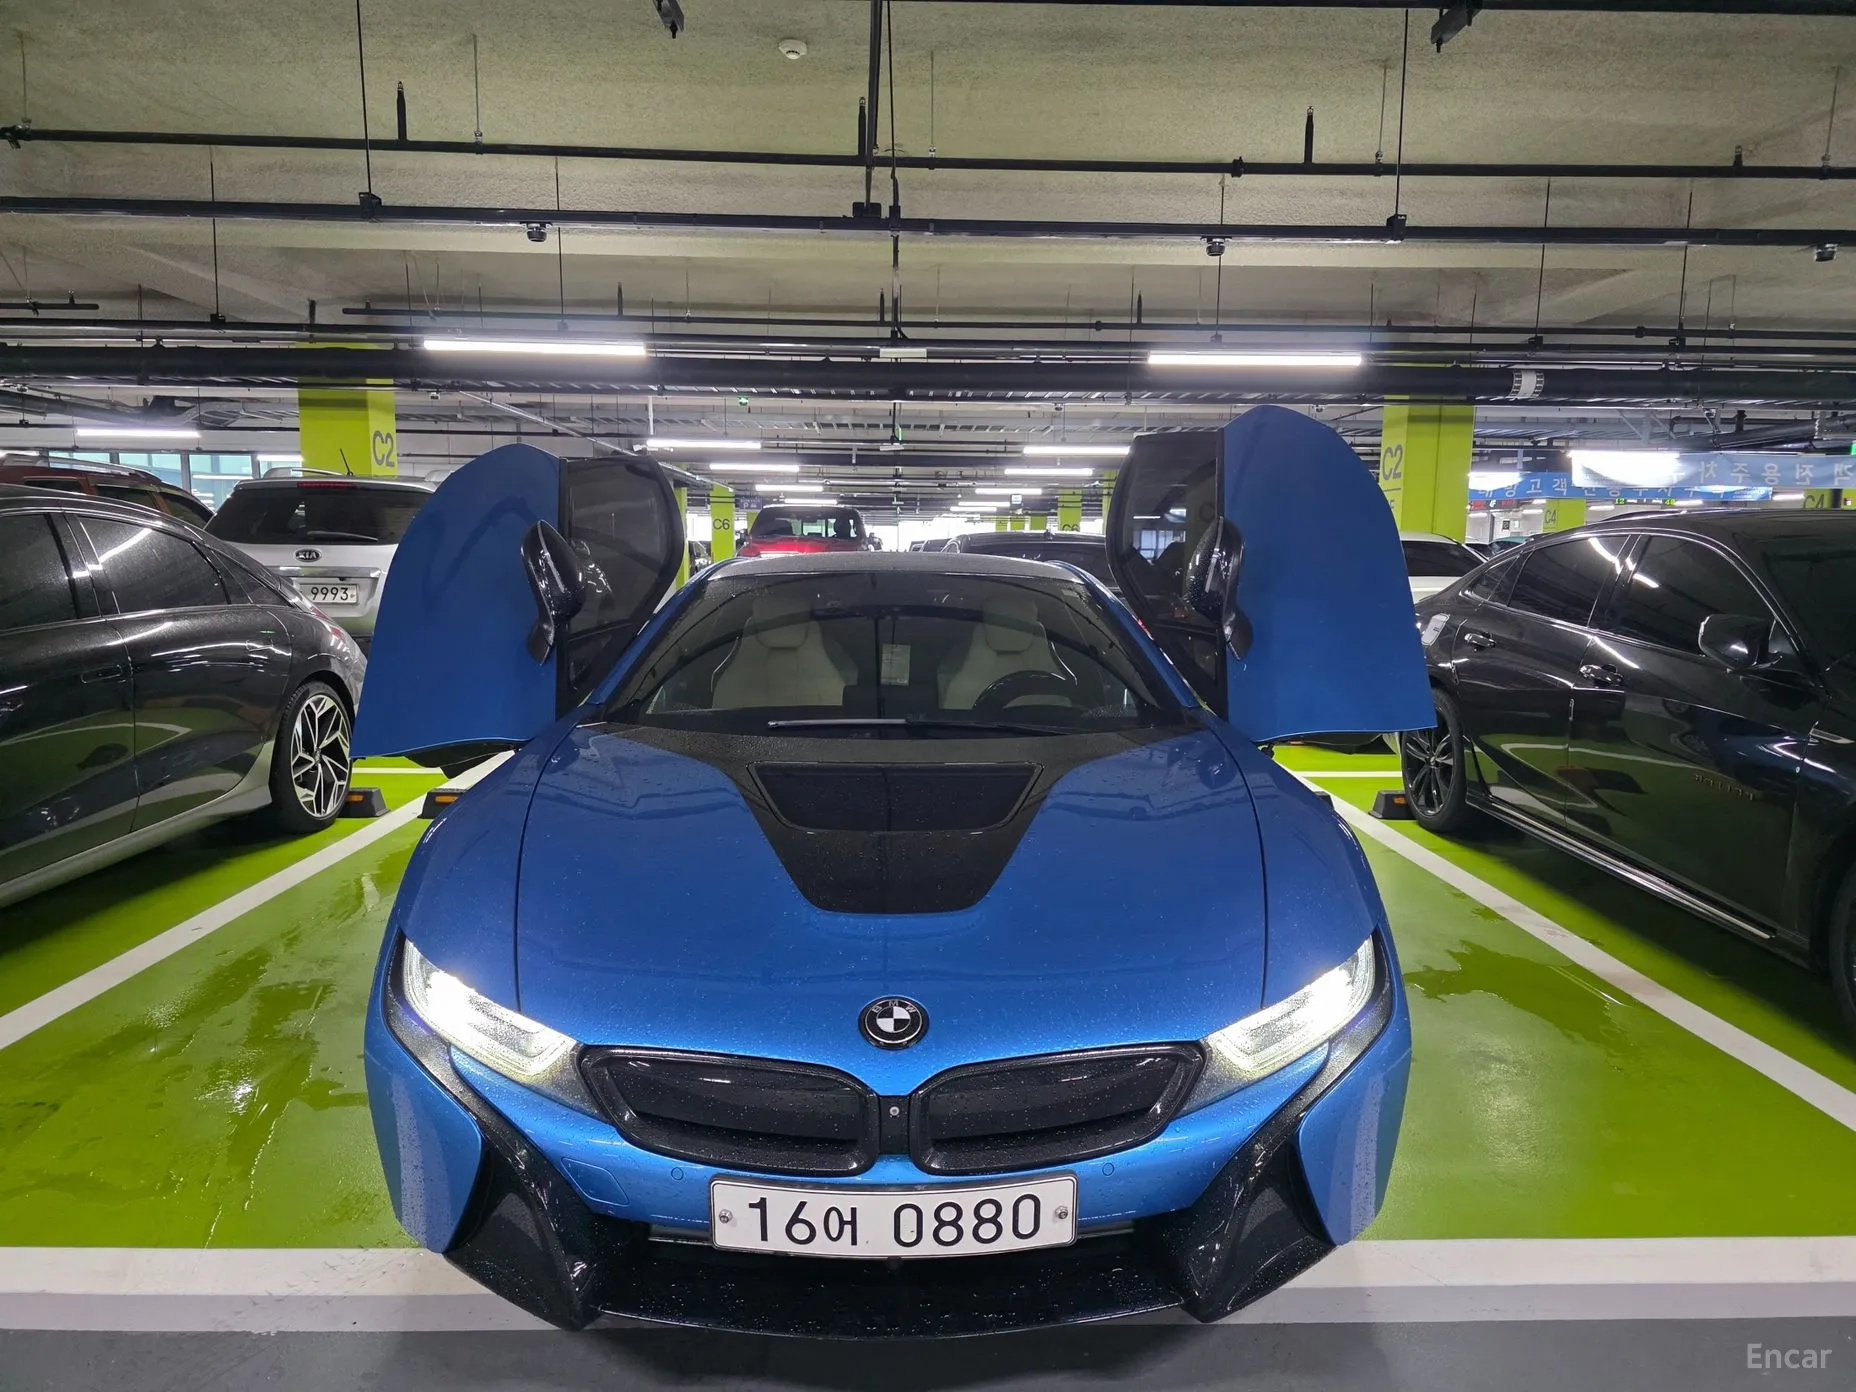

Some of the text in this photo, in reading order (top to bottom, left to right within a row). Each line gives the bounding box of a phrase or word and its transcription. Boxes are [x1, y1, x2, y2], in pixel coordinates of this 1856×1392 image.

[372, 430, 395, 468] C2
[1381, 444, 1403, 481] C2
[713, 518, 730, 530] C6
[1544, 509, 1557, 524] C4
[297, 550, 319, 560] KIA
[310, 586, 350, 601] 9993
[871, 1000, 917, 1013] BMW
[747, 1193, 1041, 1248] 16어 0880
